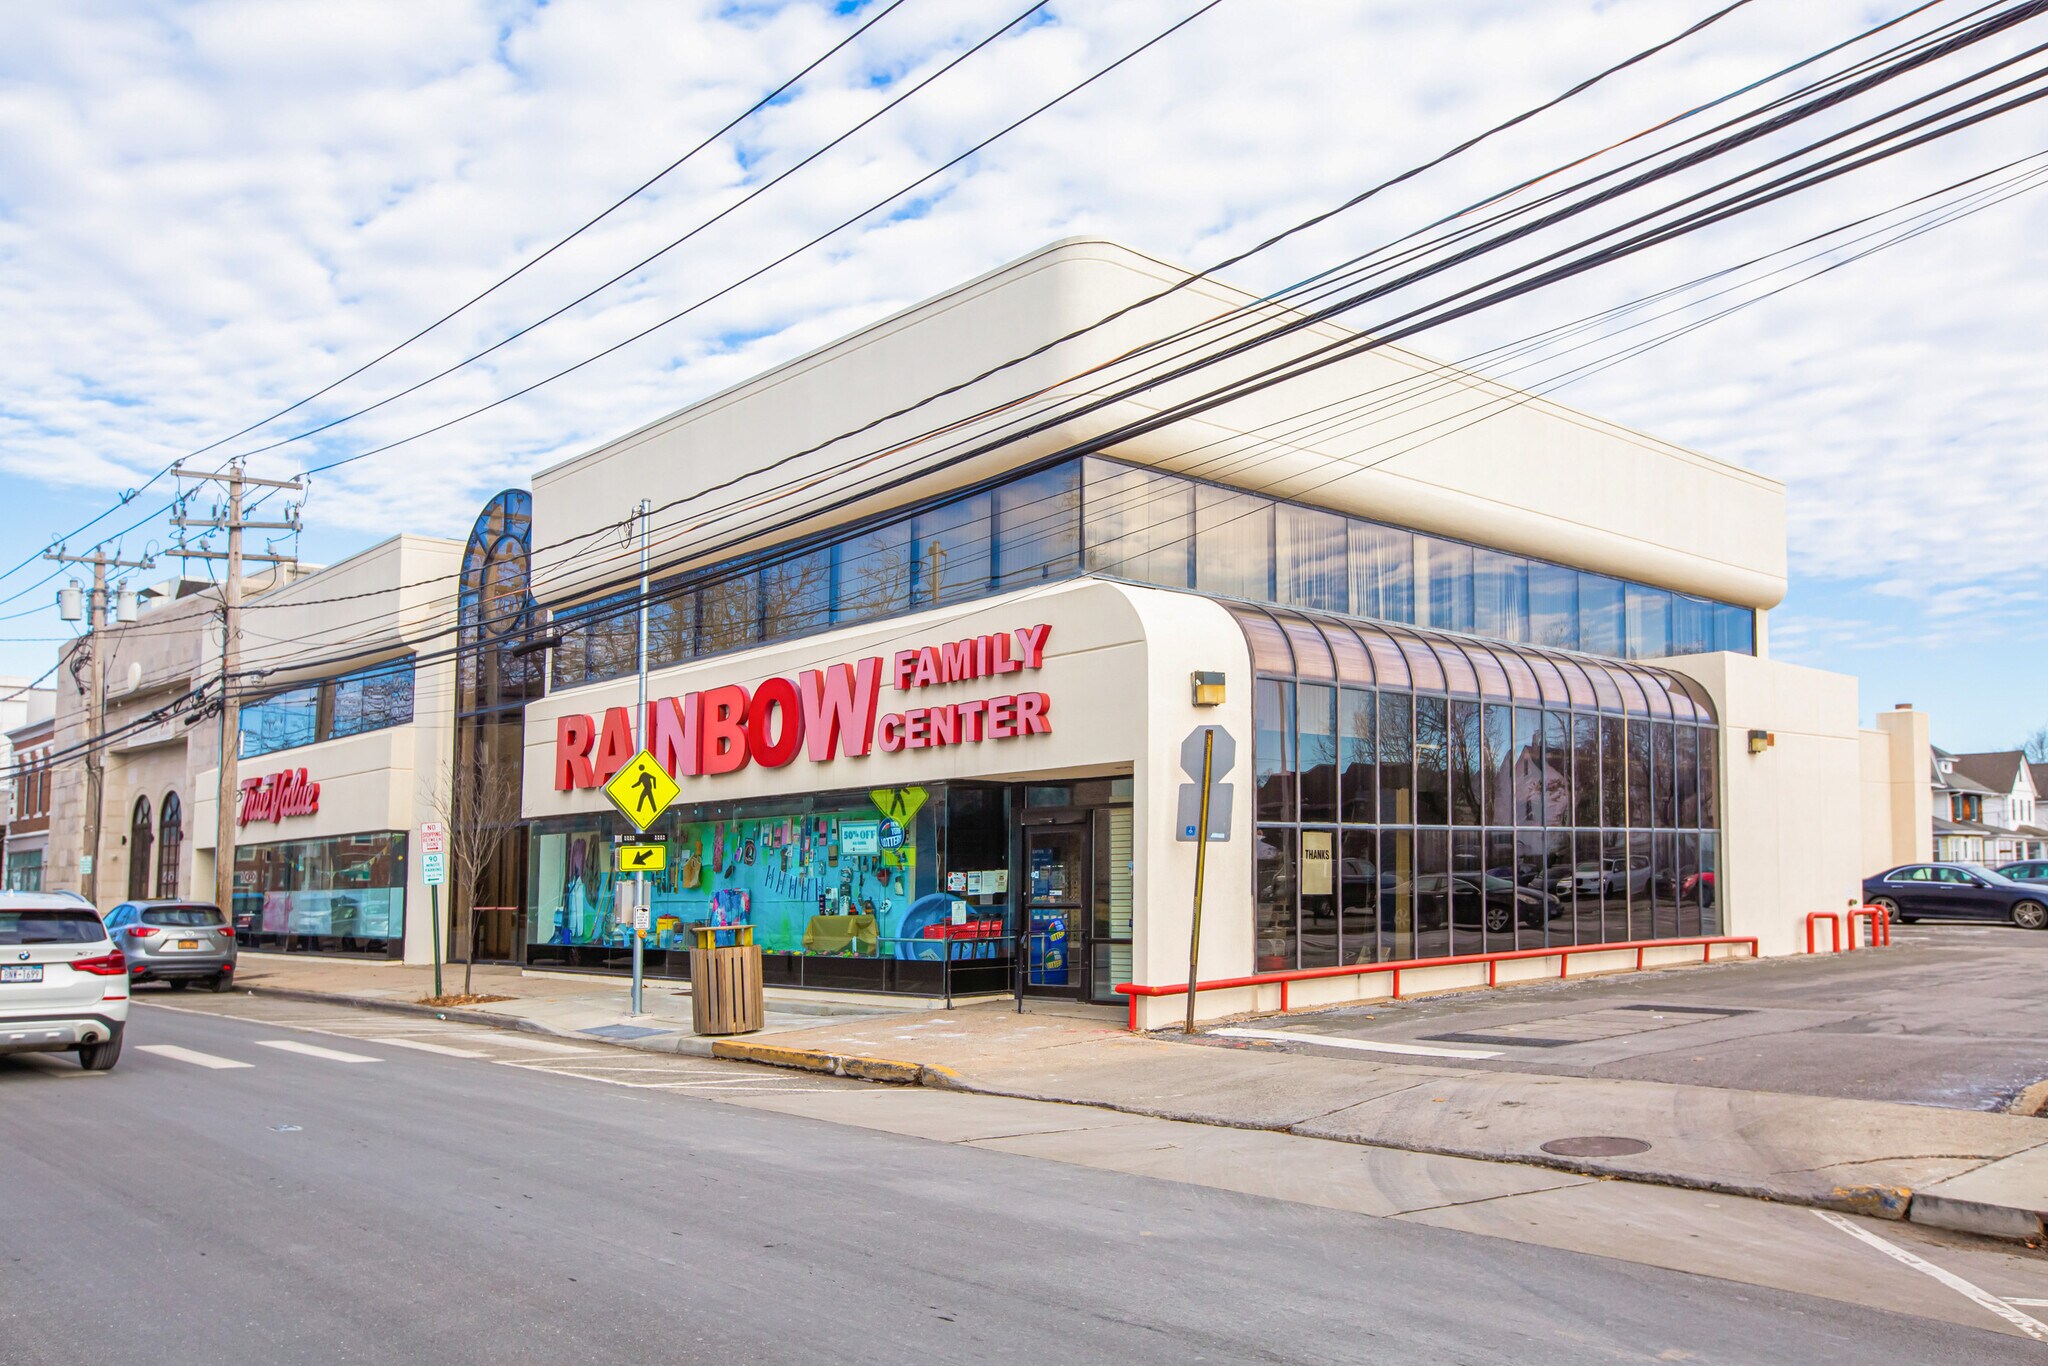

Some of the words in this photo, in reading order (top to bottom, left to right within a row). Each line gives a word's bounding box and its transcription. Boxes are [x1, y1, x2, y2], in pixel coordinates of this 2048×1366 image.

[894, 624, 1052, 690] FAMILY
[878, 692, 1052, 752] CENTER
[844, 830, 859, 839] 50%
[860, 830, 875, 839] OFF
[1305, 849, 1330, 860] THANKS
